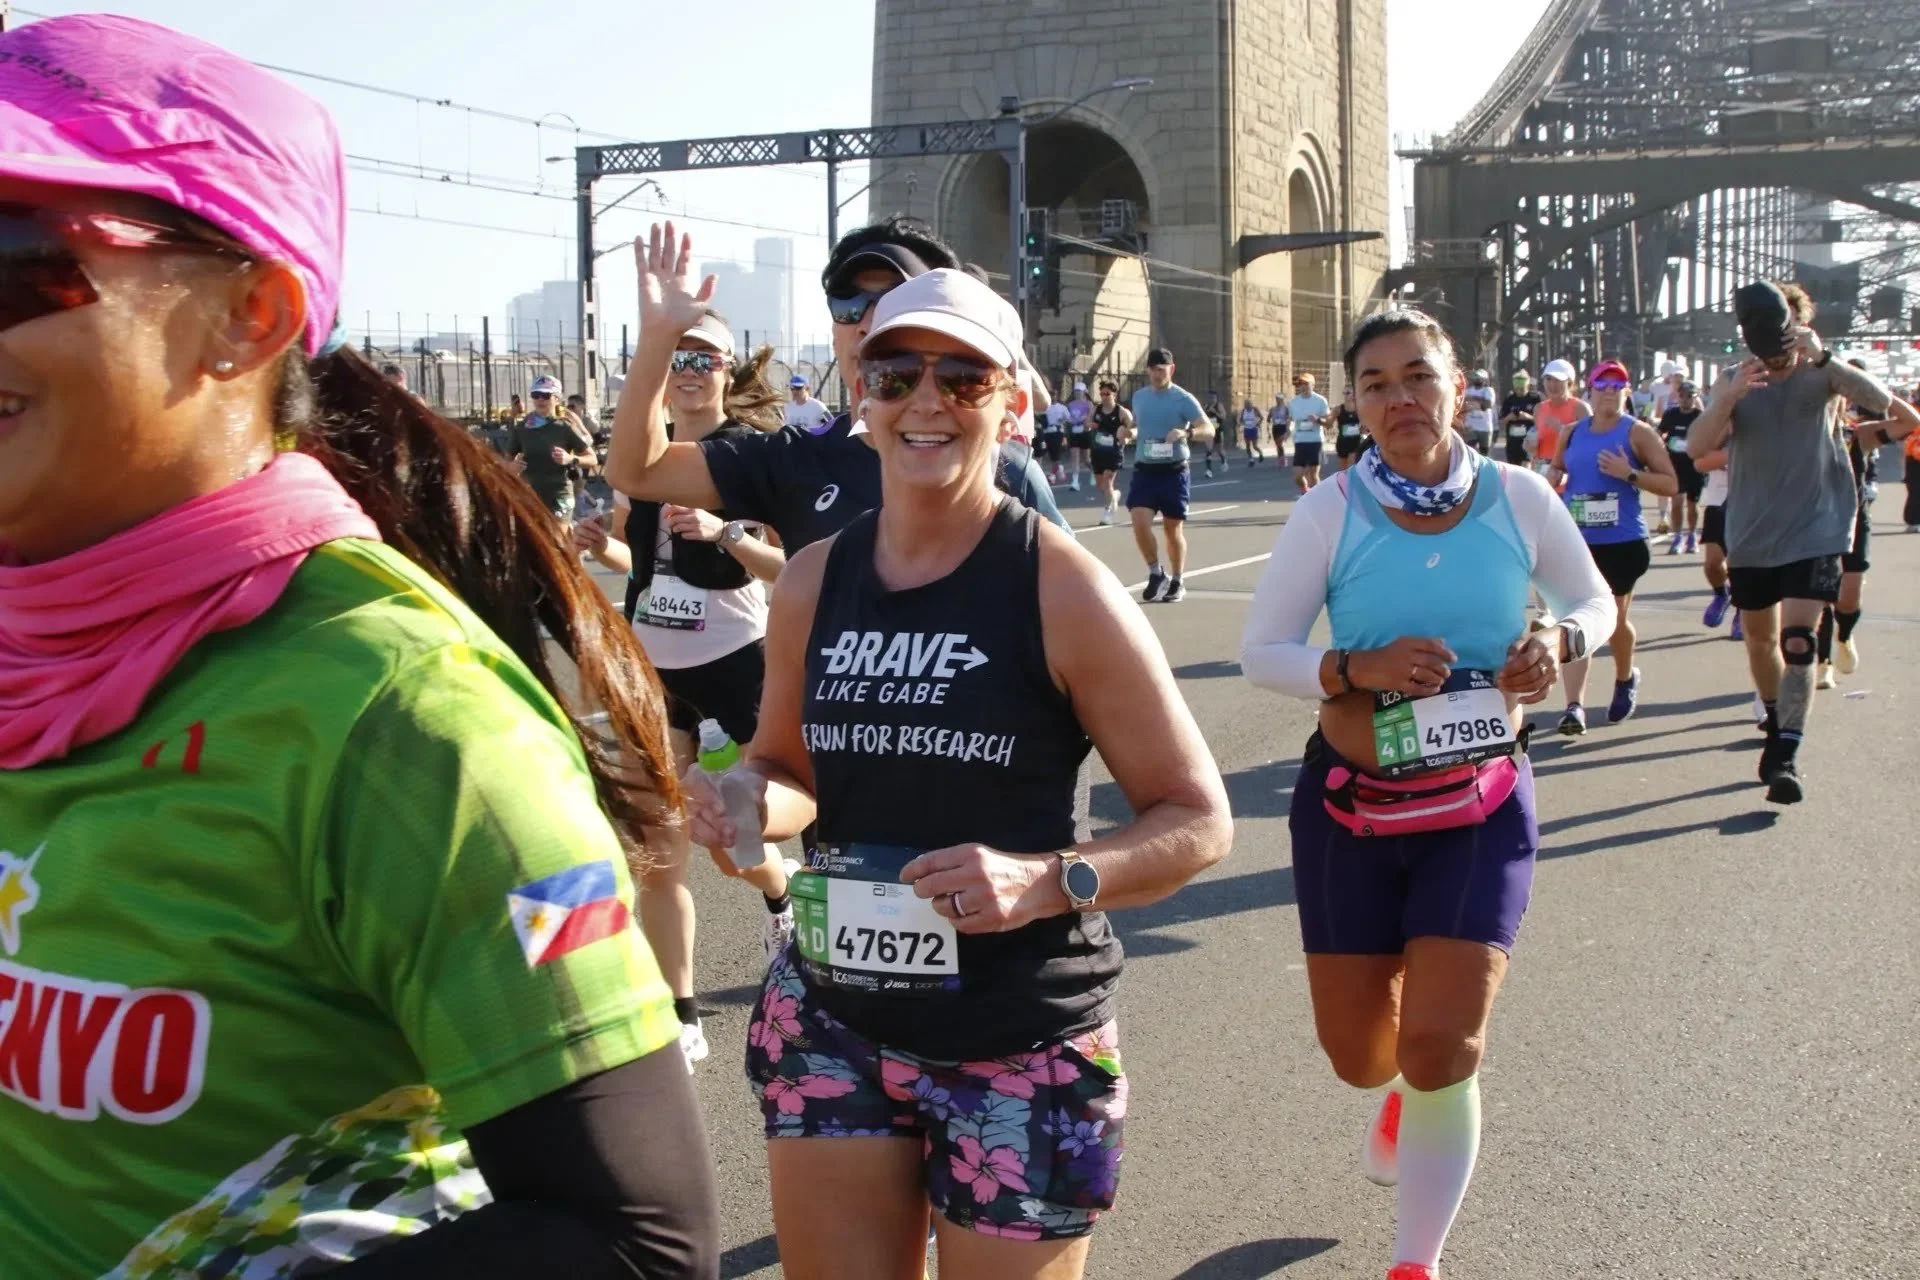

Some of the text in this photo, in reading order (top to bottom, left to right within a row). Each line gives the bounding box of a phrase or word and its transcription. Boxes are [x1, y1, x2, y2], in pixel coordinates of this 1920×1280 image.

[650, 596, 702, 616] 48443
[823, 631, 968, 678] BRAVE
[815, 680, 950, 705] LIKE GABE
[810, 723, 847, 752] RUN
[851, 724, 893, 755] FOR
[897, 725, 1016, 767] RESEARCH
[1381, 742, 1395, 757] 4
[1403, 736, 1416, 755] D
[1426, 717, 1506, 748] 47986
[797, 922, 946, 966] 4 D 47672
